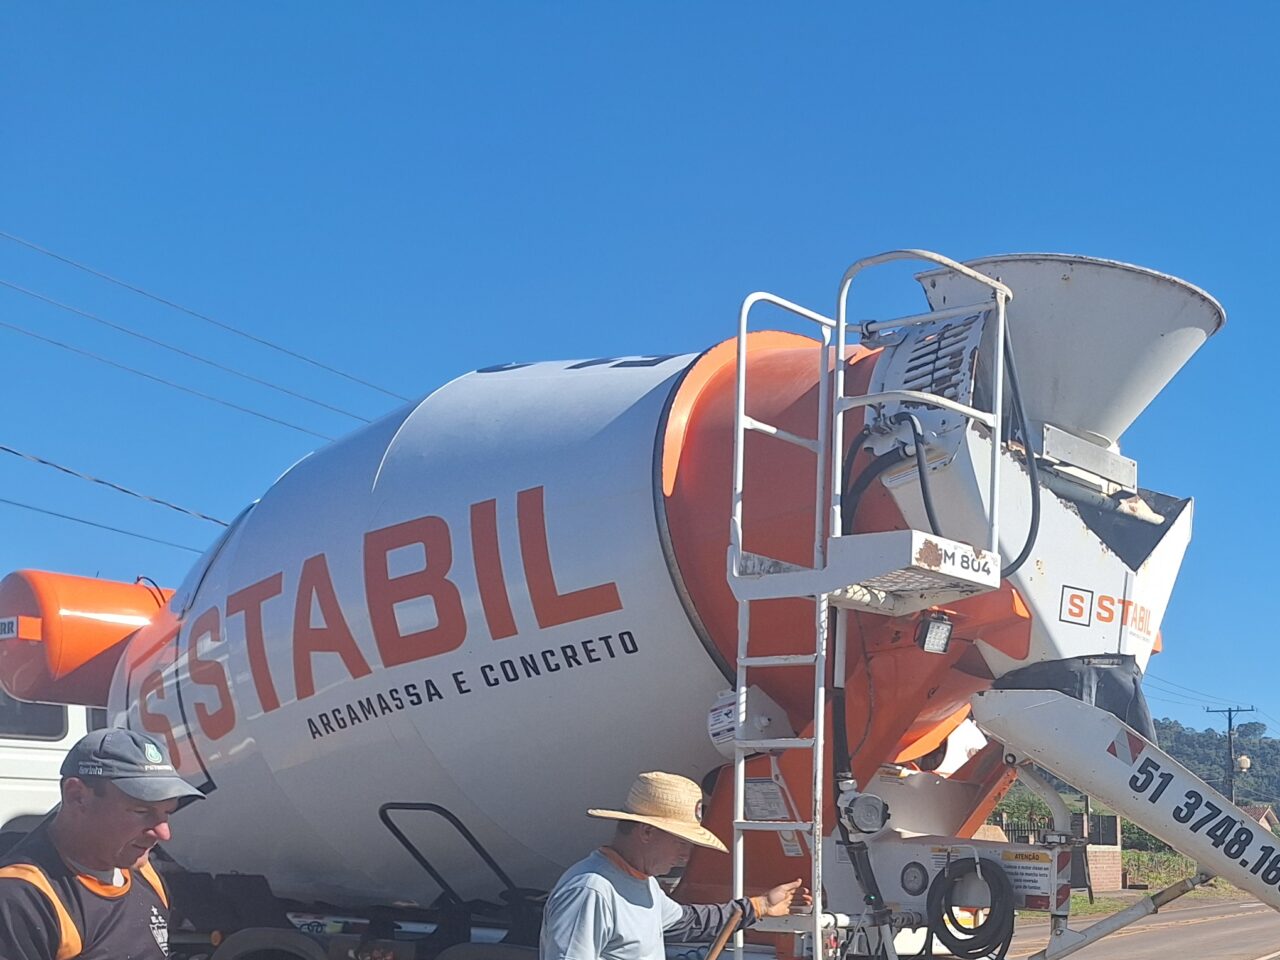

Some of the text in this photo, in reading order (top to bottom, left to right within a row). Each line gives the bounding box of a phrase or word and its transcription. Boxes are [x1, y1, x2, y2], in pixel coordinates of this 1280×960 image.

[961, 554, 992, 577] 804
[188, 485, 624, 742] STABIL
[1067, 593, 1152, 636] S STABIL
[307, 630, 639, 740] ARGAMASSA E CONCRETO
[1128, 756, 1175, 805] 51
